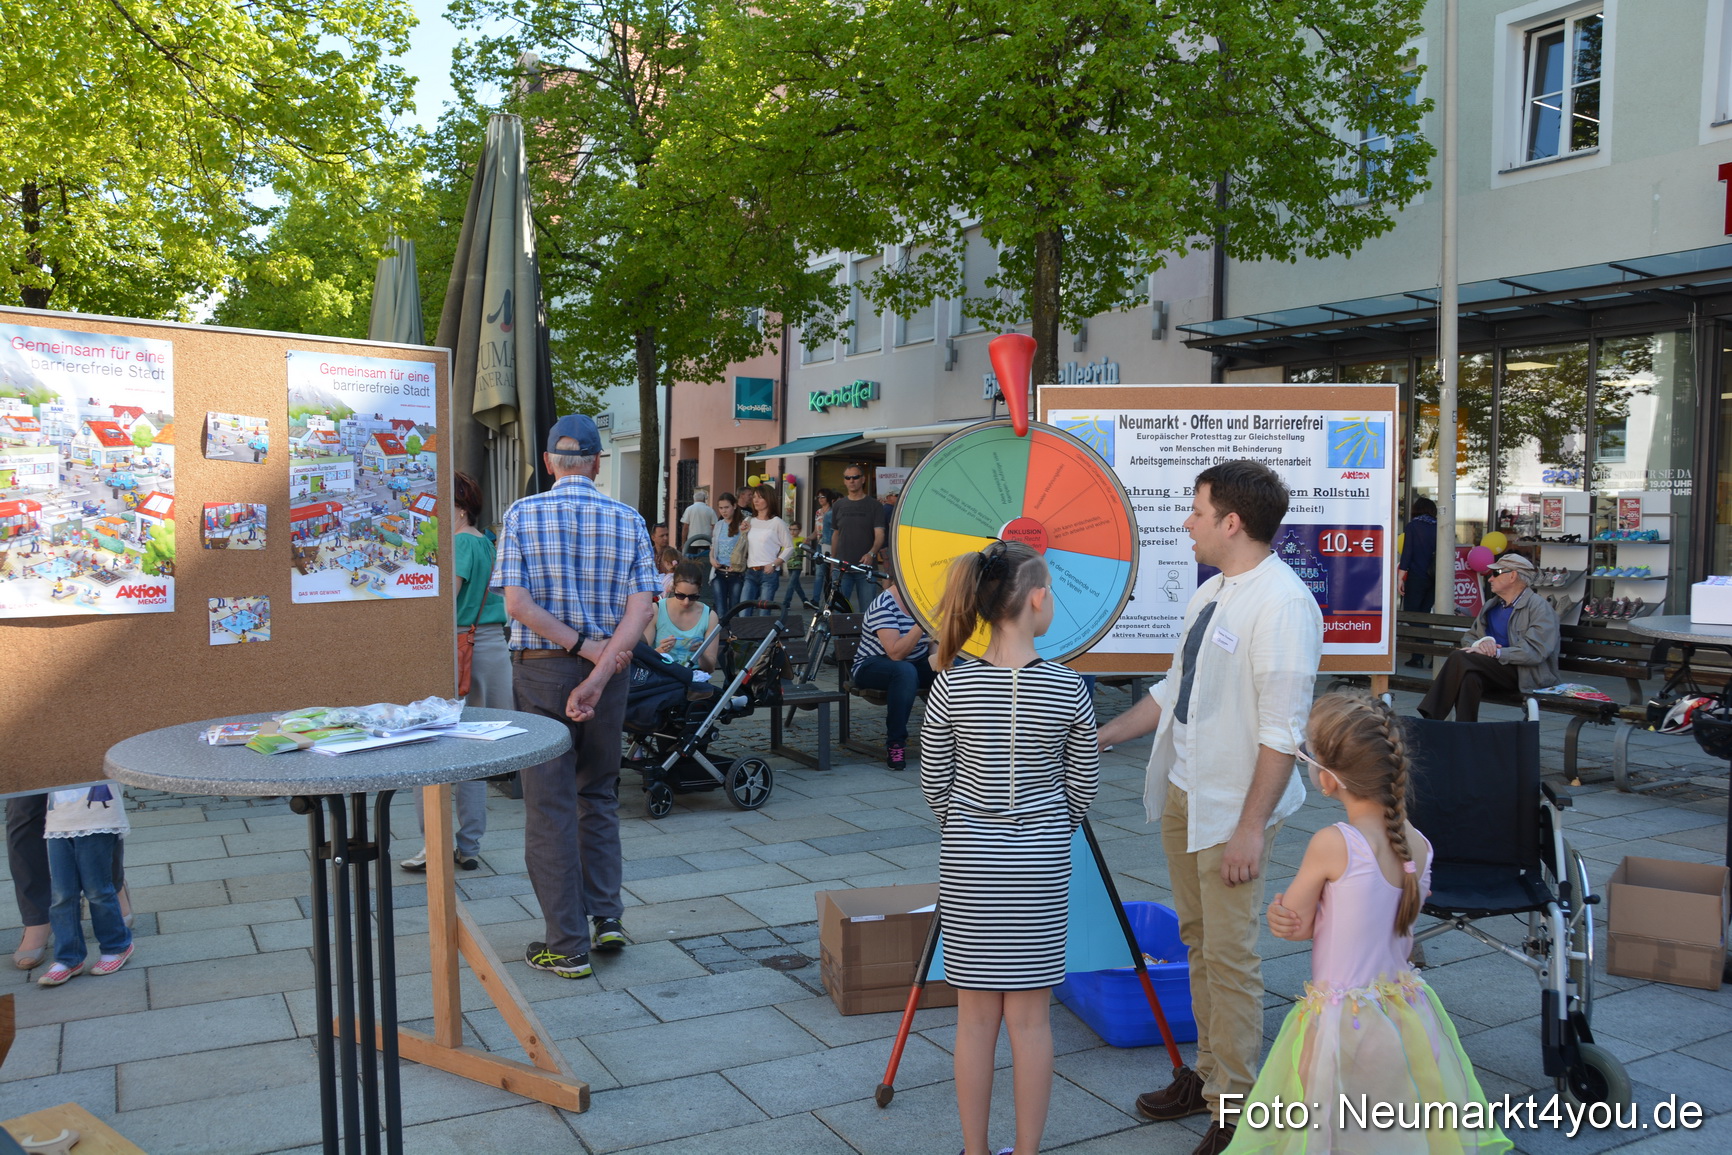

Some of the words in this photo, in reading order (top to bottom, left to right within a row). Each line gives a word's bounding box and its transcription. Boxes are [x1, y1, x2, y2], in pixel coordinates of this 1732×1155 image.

[11, 336, 105, 358] Gemeinsam
[110, 346, 130, 361] für
[135, 349, 165, 364] eine
[31, 355, 123, 376] barrierefreie
[128, 364, 165, 380] Stadt
[320, 362, 387, 380] Gemeinsam
[390, 368, 405, 381] für
[408, 372, 430, 383] eine
[1058, 356, 1120, 385] ellegrin
[333, 379, 400, 395] barrierefreie
[403, 384, 431, 398] Stadt
[809, 379, 874, 413] Kochlöffel
[737, 403, 772, 413] Kochlöffel
[1119, 414, 1179, 430] Neumarkt
[1191, 414, 1223, 430] Offen
[1227, 414, 1249, 430] und
[1253, 414, 1323, 431] Barrierefrei
[1136, 432, 1188, 441] Europäischer
[1191, 433, 1232, 442] Protesttag
[1248, 433, 1305, 443] Gleichstellung
[1175, 445, 1214, 453] Menschen
[1217, 445, 1230, 453] mit
[1233, 445, 1282, 454] Behinderung
[1130, 456, 1210, 467] Arbeitsgemeinschaft
[1658, 469, 1675, 479] SIE
[1677, 468, 1692, 479] DA
[1649, 480, 1672, 488] 19.00
[1674, 480, 1692, 488] UHR
[1124, 486, 1170, 499] ahrung
[1289, 489, 1308, 497] em
[1313, 487, 1370, 498] Rollstuhl
[1674, 488, 1692, 496] UHR
[1133, 504, 1155, 512] eben
[1157, 504, 1171, 512] sie
[1286, 505, 1325, 515] reiheit!)
[1455, 558, 1472, 571] ale
[1064, 569, 1089, 590] Gemeinde
[1066, 579, 1083, 595] Verein
[138, 597, 167, 605] MENSCH
